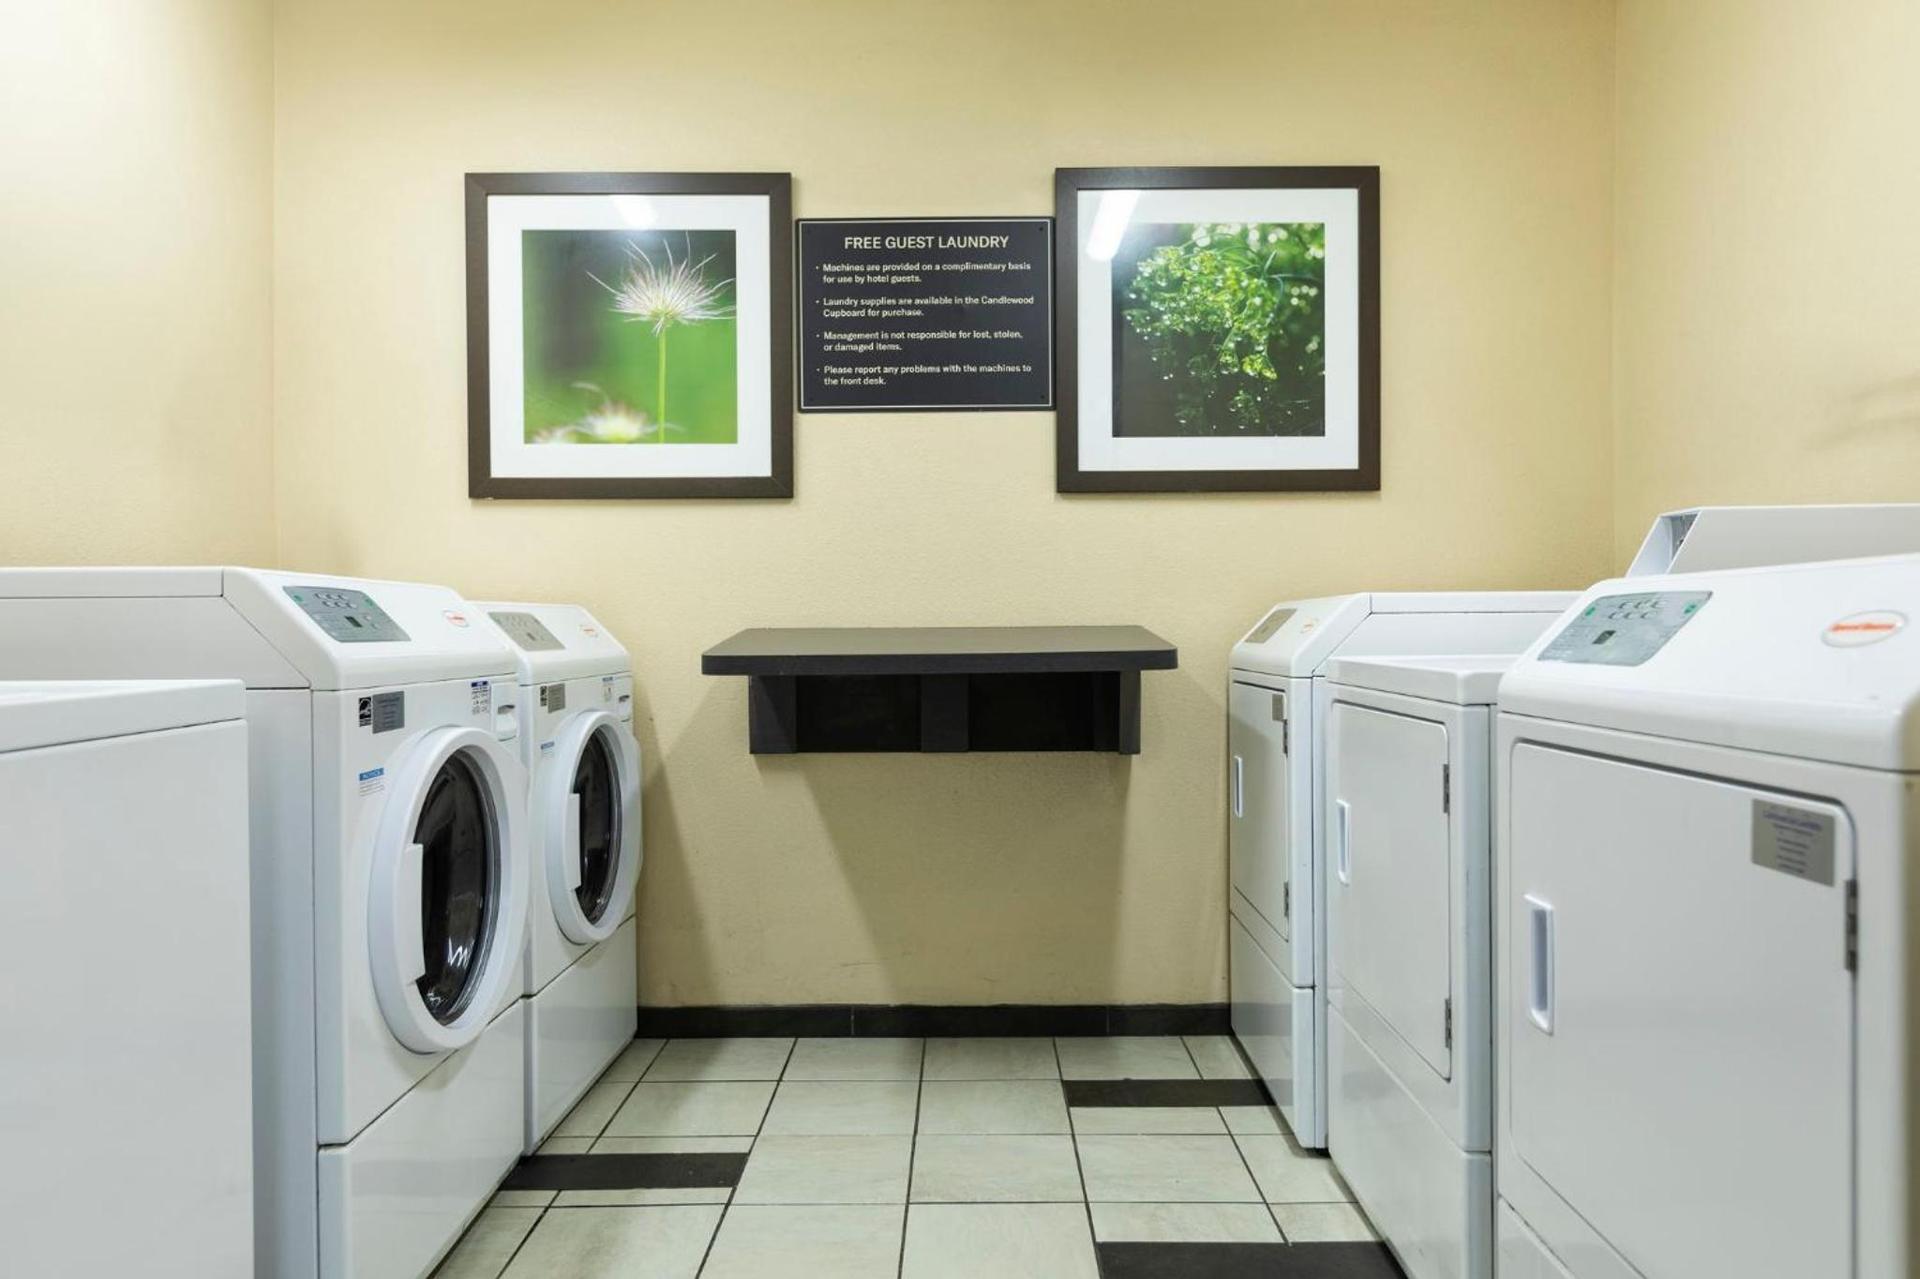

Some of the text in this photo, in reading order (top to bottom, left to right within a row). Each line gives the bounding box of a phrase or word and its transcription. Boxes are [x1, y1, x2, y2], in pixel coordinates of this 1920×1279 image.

[844, 235, 1009, 249] FREE GUEST LAUNDRY
[823, 263, 865, 272] Machines
[866, 264, 881, 272] are
[882, 262, 920, 273] provided
[941, 262, 1007, 272] complimentary
[1008, 261, 1031, 270] basis
[823, 275, 835, 284] for
[854, 274, 865, 284] by
[867, 274, 889, 283] hotel
[890, 275, 922, 284] guests.
[823, 297, 858, 307] Laundry
[860, 296, 897, 307] supplies
[914, 296, 953, 305] available
[954, 296, 963, 304] in
[964, 296, 980, 304] the
[981, 296, 1034, 304] Candlewood
[823, 308, 924, 318] Cupboard for purchase.
[824, 331, 879, 342] Management
[881, 331, 889, 339] is
[890, 331, 905, 339] not
[907, 330, 957, 340] responsible
[958, 330, 972, 339] for
[834, 342, 874, 353] damaged
[876, 342, 902, 351] items.
[824, 364, 1032, 375] Please report any problems with the machines to
[824, 376, 886, 385] the front desk.
